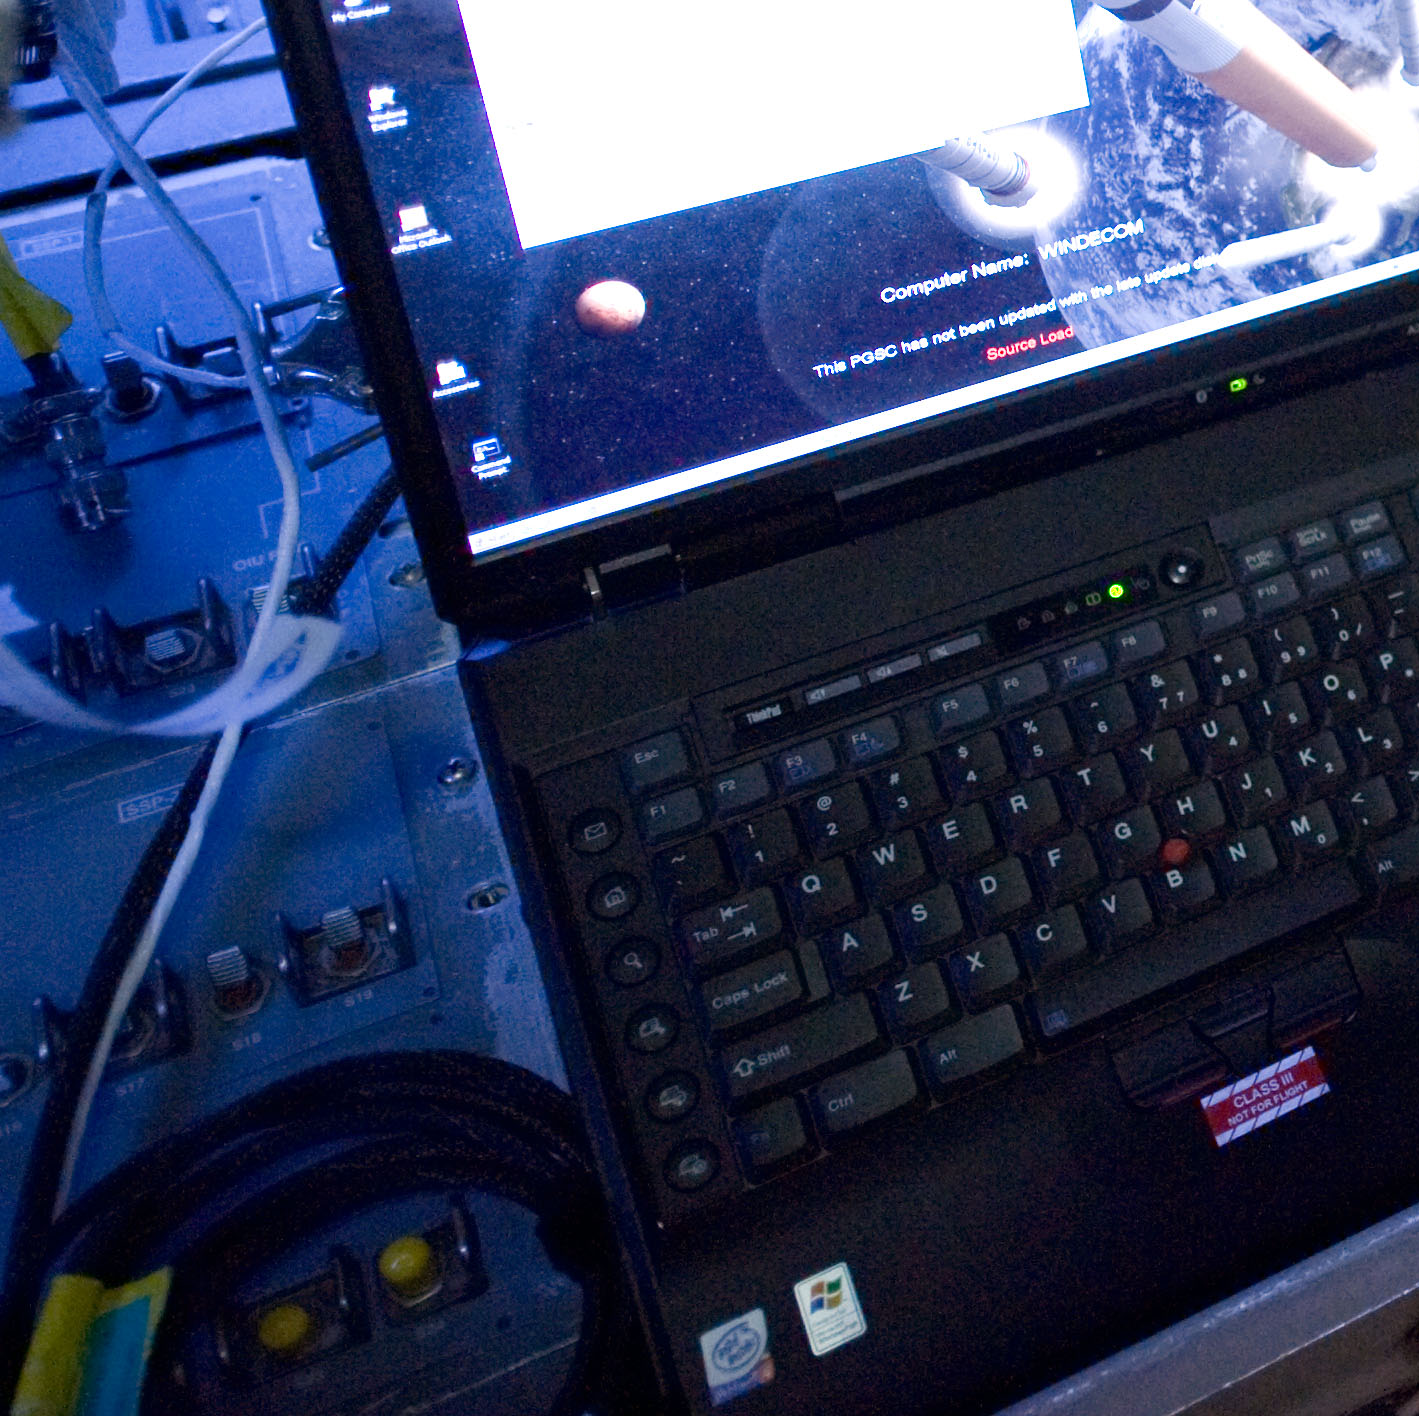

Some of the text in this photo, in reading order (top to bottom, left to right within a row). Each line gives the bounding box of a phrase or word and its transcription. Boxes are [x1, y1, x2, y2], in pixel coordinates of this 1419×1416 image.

[880, 218, 1144, 304] Computer Name: WINDECOM
[812, 359, 847, 379] This
[850, 344, 898, 369] PGSC
[901, 337, 930, 354] has
[932, 329, 957, 345] not
[959, 318, 995, 337] been
[999, 299, 1057, 326] updated
[1059, 290, 1088, 309] with
[1091, 282, 1114, 300] the
[1116, 274, 1142, 292] late
[1144, 261, 1191, 284] update
[986, 325, 1075, 361] Source Load
[1378, 651, 1395, 672] P
[1201, 719, 1219, 739] U
[1356, 726, 1375, 744] L
[634, 748, 659, 765] Esc
[1138, 743, 1156, 763] Y
[1297, 746, 1317, 767] K
[1076, 766, 1093, 786] T
[1240, 771, 1254, 792] J
[1008, 794, 1029, 815] R
[1175, 794, 1196, 816] H
[941, 819, 961, 841] E
[1113, 821, 1133, 841] G
[1289, 814, 1312, 837] M
[871, 843, 897, 866] W
[1046, 847, 1062, 869] F
[1227, 841, 1248, 862] N
[800, 873, 823, 895] Q
[978, 875, 999, 897] D
[1165, 869, 1185, 890] B
[910, 902, 929, 923] S
[1100, 894, 1117, 914] V
[692, 927, 720, 943] Tab
[841, 931, 860, 953] A
[1035, 922, 1054, 943] C
[965, 950, 986, 973] X
[711, 972, 789, 1010] Caps Lock
[894, 980, 914, 1002] Z
[757, 1044, 793, 1067] Shift
[827, 1092, 855, 1113] Ctrl
[1227, 1080, 1309, 1127] NOT FOR FLIGHT
[1233, 1078, 1280, 1108] CLASS
